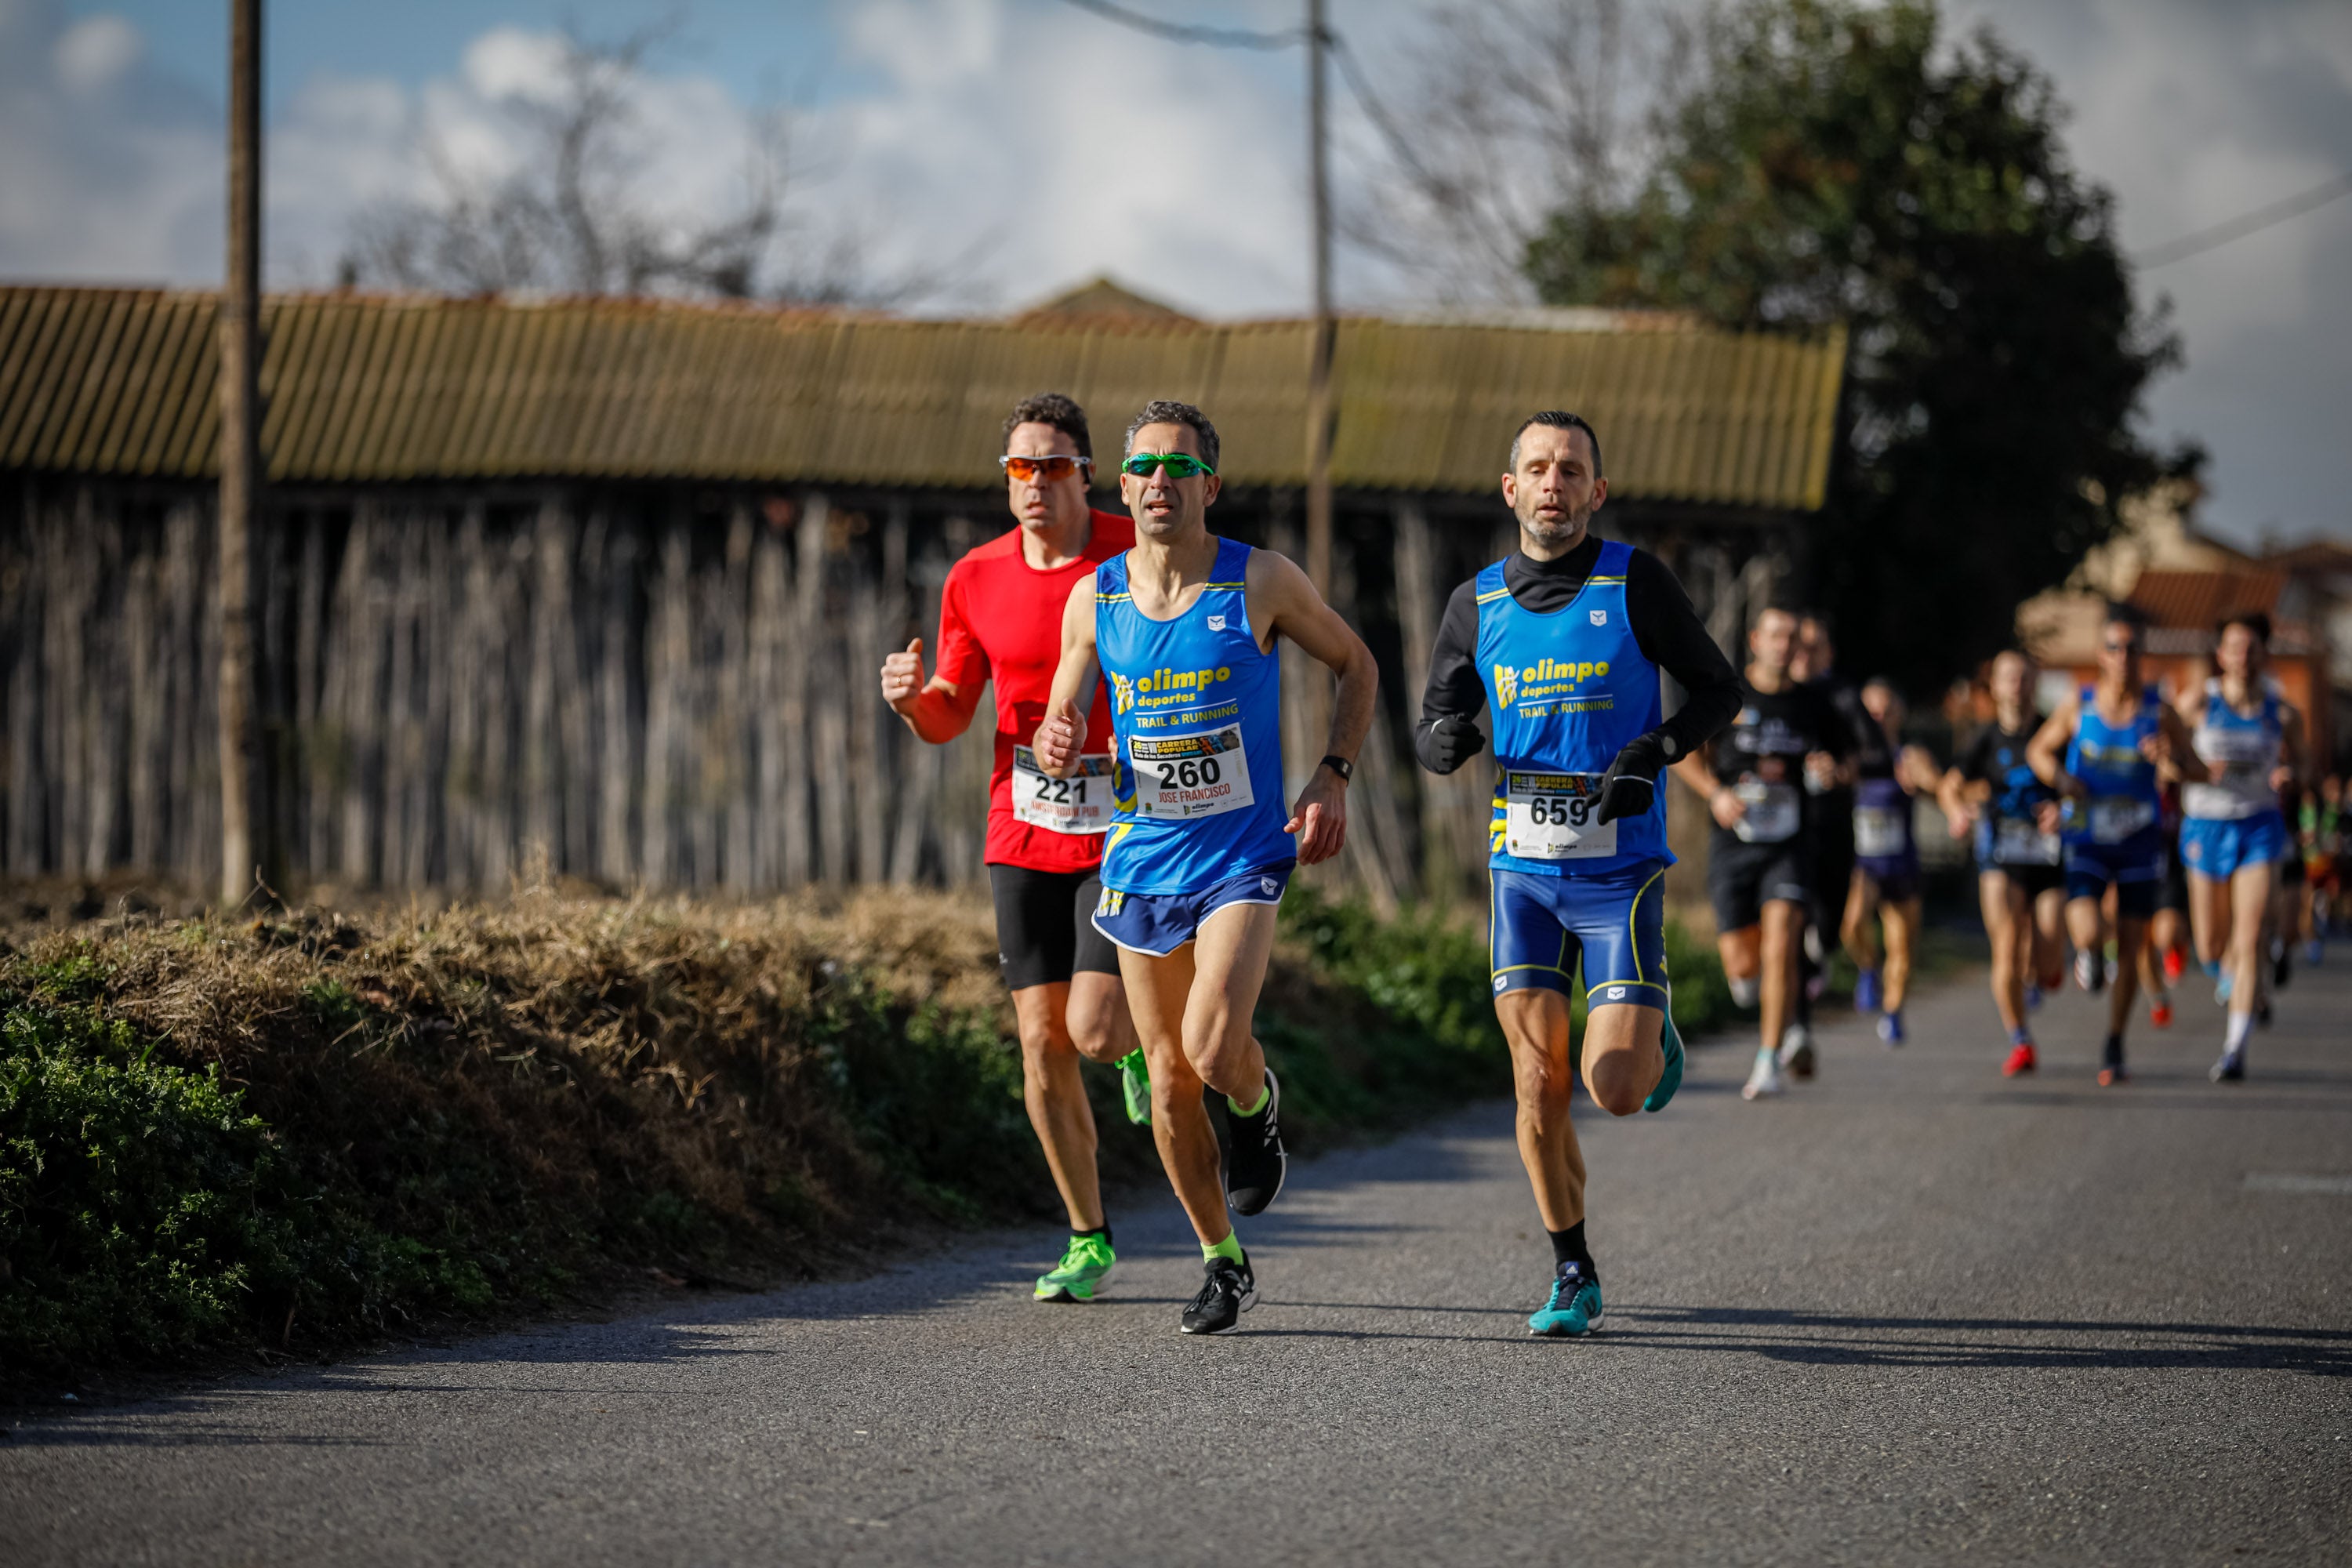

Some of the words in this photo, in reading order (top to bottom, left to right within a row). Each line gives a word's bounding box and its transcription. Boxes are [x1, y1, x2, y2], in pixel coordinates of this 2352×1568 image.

[1137, 666, 1231, 692] olimpo
[1522, 658, 1610, 683] olimpo
[1138, 693, 1196, 709] deportes
[1521, 683, 1575, 699] deportes
[1135, 717, 1167, 728] TRAIL
[1170, 715, 1179, 725] &
[1181, 703, 1239, 724] RUNNING
[1519, 706, 1548, 719] TRAIL
[1551, 705, 1559, 714] &
[1561, 699, 1613, 713] RUNNING
[1156, 739, 1198, 749] CARRERA
[1157, 745, 1199, 753] POPULAR
[1156, 757, 1221, 789] 260
[1036, 776, 1087, 804] 221
[1159, 792, 1178, 803] JOSE
[1180, 782, 1231, 802] FRANCISCO
[1081, 805, 1100, 817] PUB
[1531, 797, 1589, 826] 659
